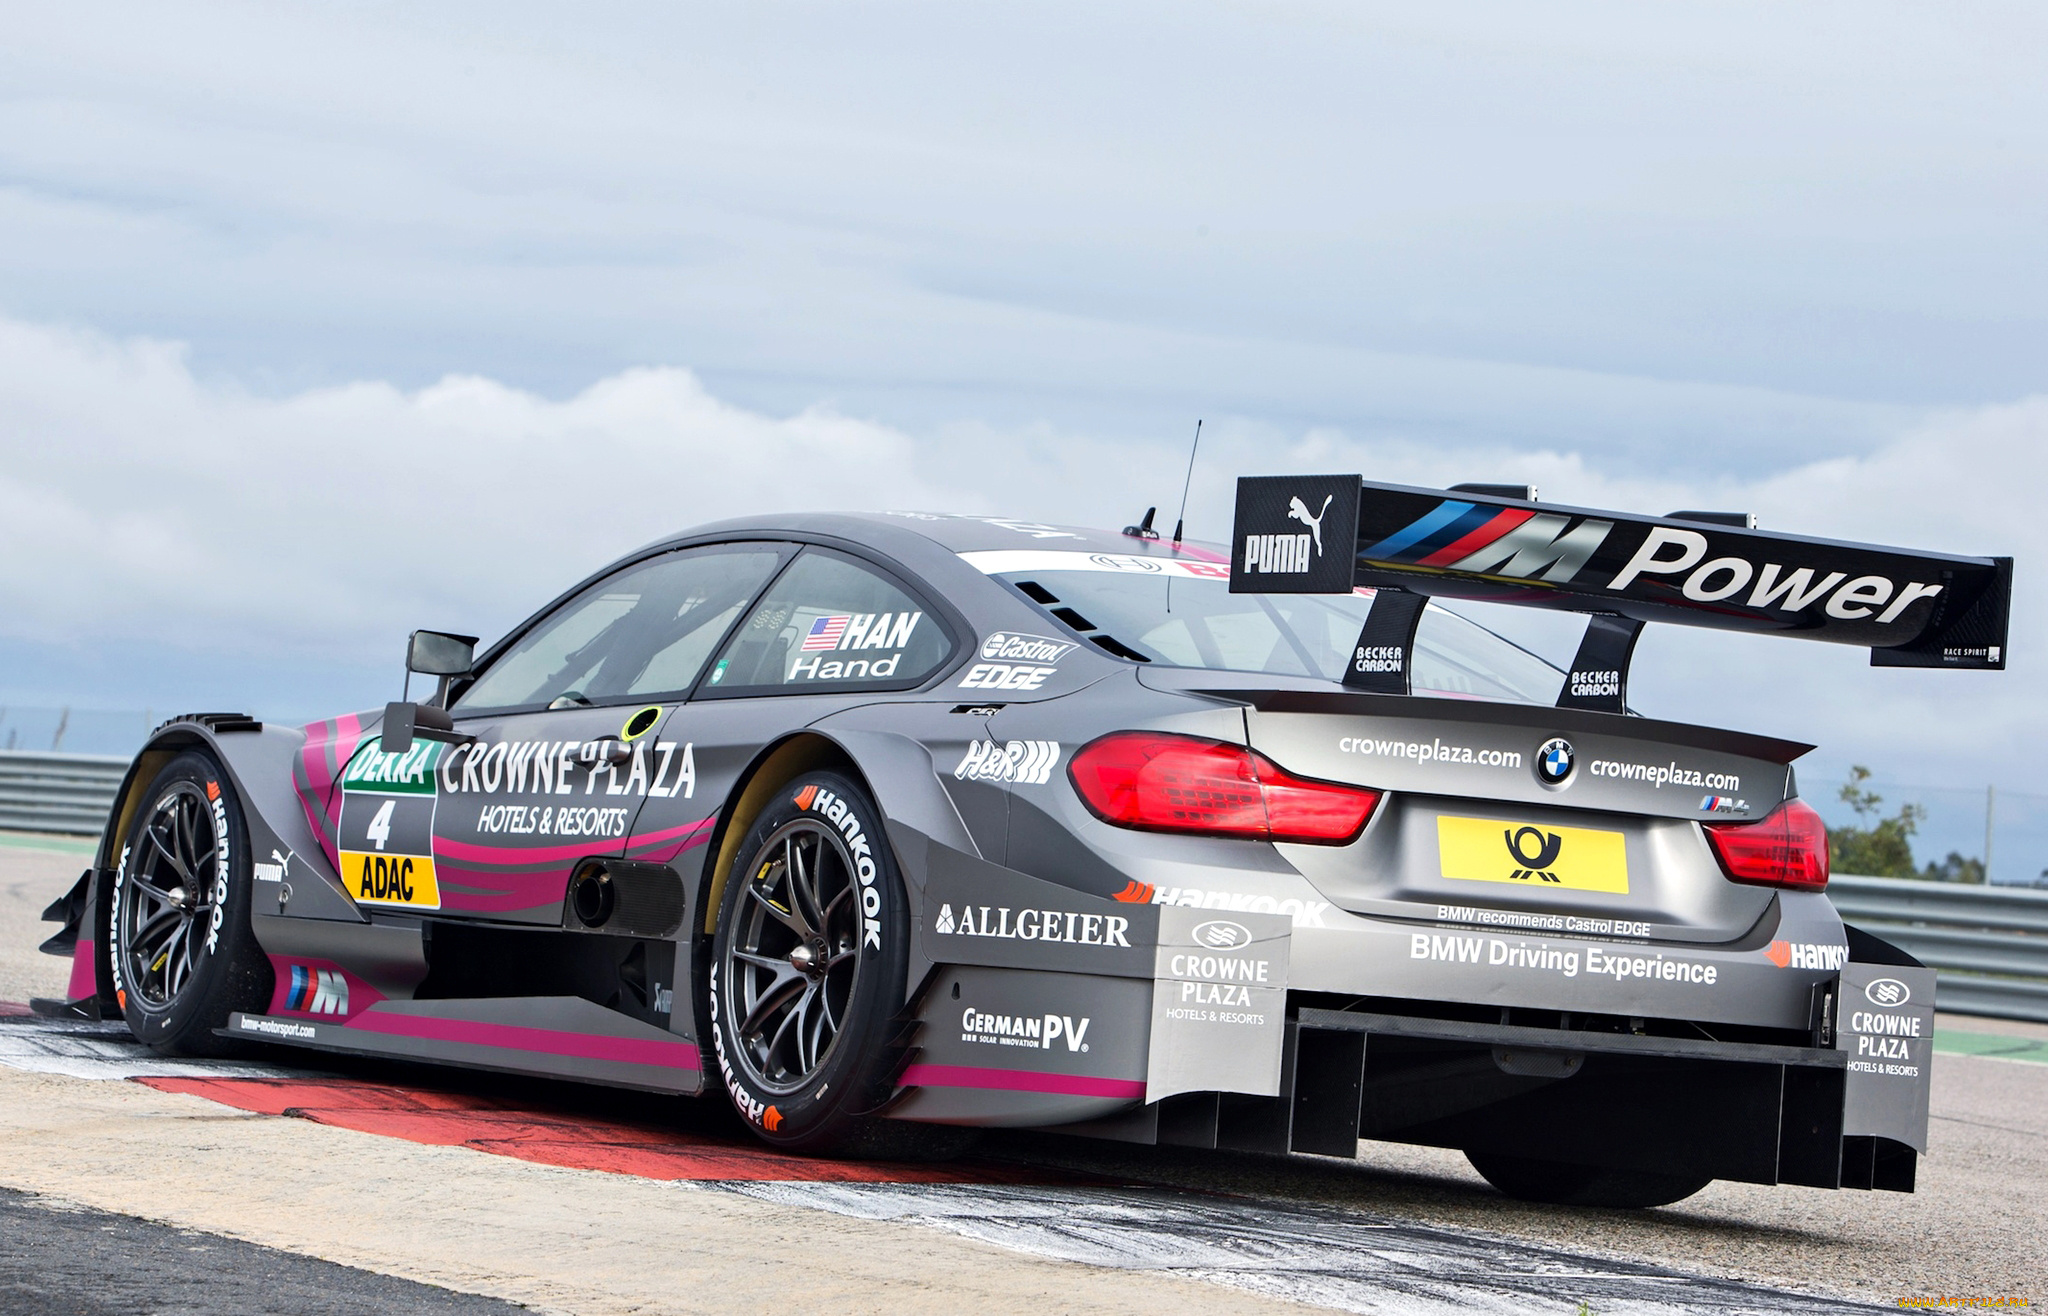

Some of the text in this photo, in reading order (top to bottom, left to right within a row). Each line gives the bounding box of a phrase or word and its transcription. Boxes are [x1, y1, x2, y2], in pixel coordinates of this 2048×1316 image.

[1244, 534, 1310, 573] PUMA
[1606, 526, 1943, 624] Power
[839, 612, 922, 650] HAN
[998, 636, 1069, 661] Castrol
[1356, 646, 1402, 660] BECKER
[1943, 648, 1987, 656] RACE SPIRIT
[788, 653, 901, 680] Hand
[957, 664, 1057, 690] EDGE
[1355, 659, 1401, 672] CARBON
[1571, 671, 1618, 684] BECKER
[1571, 683, 1619, 697] CARBON
[347, 742, 425, 784] DEKRA
[1339, 736, 1521, 768] crowneplaza.com
[442, 741, 697, 798] CROWNE PLAZA
[1590, 757, 1740, 791] crowneplaza.com
[366, 800, 396, 850] 4
[477, 805, 628, 837] HOTELS & RESORTS
[254, 863, 283, 882] PUMA
[360, 856, 414, 902] ADAC
[956, 904, 1131, 948] ALLGEIER
[1437, 905, 1651, 937] BMW recommends Castrol EDGE
[1171, 954, 1269, 982] CROWNE
[1410, 933, 1718, 985] BMW Driving Experience
[1182, 982, 1251, 1007] PLAZA
[241, 1015, 315, 1038] bmw-motorsport.com
[1166, 1008, 1264, 1025] HOTELS & RESORTS
[1851, 1011, 1921, 1037] CROWNE
[979, 1035, 1039, 1048] SOLAR INNOVATION
[1858, 1036, 1909, 1060] PLAZA
[1847, 1060, 1919, 1077] HOTELS & RESORTS
